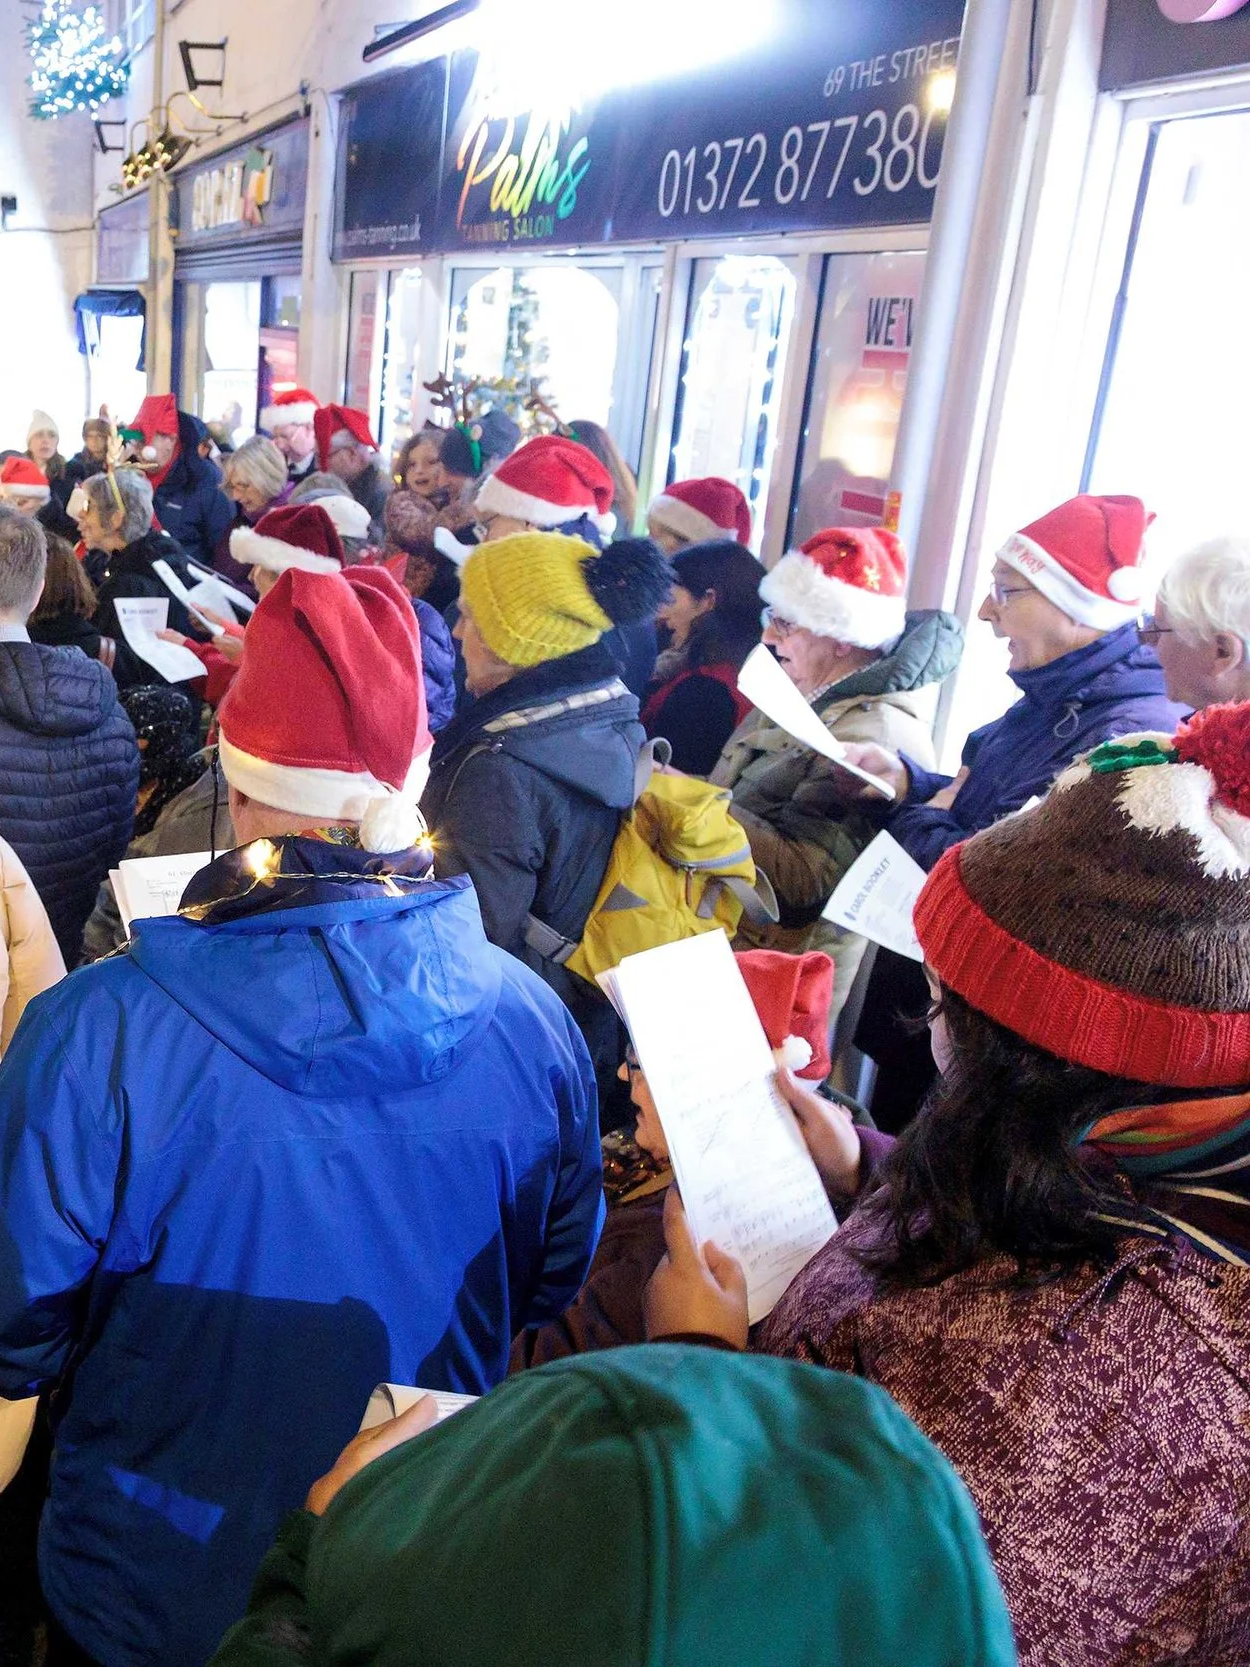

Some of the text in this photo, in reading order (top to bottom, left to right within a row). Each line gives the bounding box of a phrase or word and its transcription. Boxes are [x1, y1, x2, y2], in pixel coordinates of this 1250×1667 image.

[823, 66, 846, 98] 69
[850, 55, 886, 92] THE
[456, 112, 592, 232] Palms
[658, 133, 767, 217] 01372
[461, 215, 554, 242] TANNING SALON
